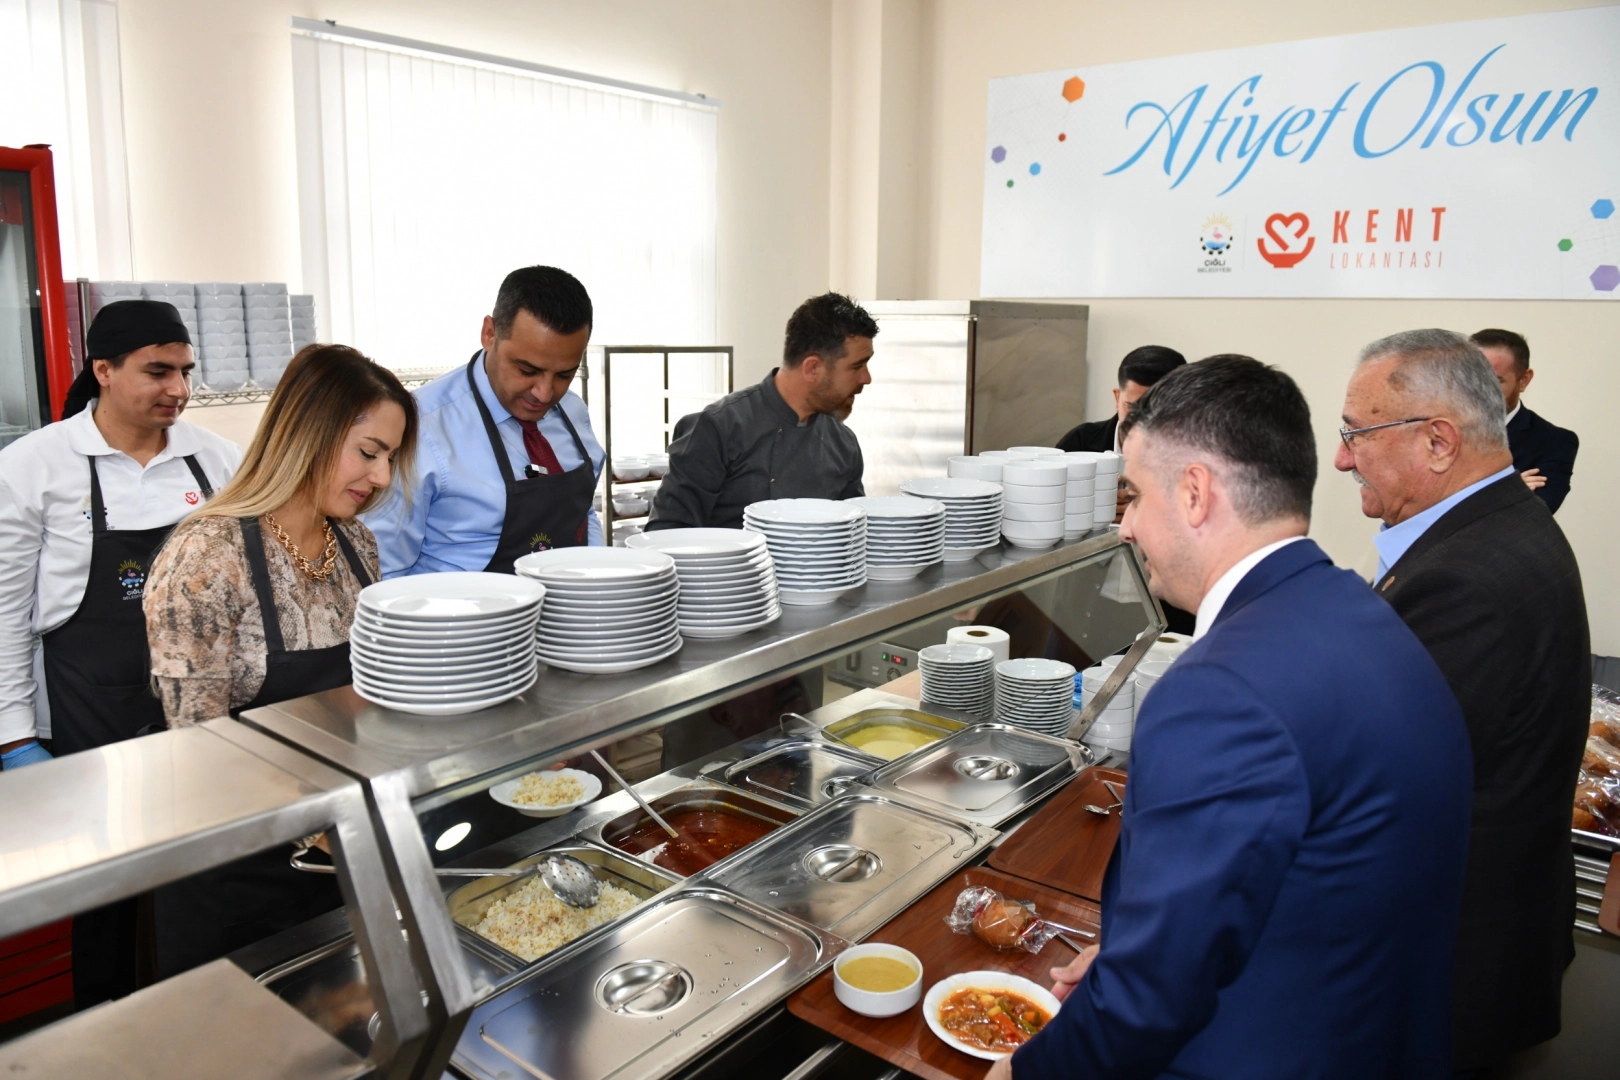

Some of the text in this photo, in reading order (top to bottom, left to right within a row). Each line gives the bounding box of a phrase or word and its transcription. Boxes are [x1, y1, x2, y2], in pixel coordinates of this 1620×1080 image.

[1102, 43, 1600, 198] Afiyet Olsun
[1332, 206, 1447, 244] KENT
[1330, 251, 1443, 270] LOKANTASI
